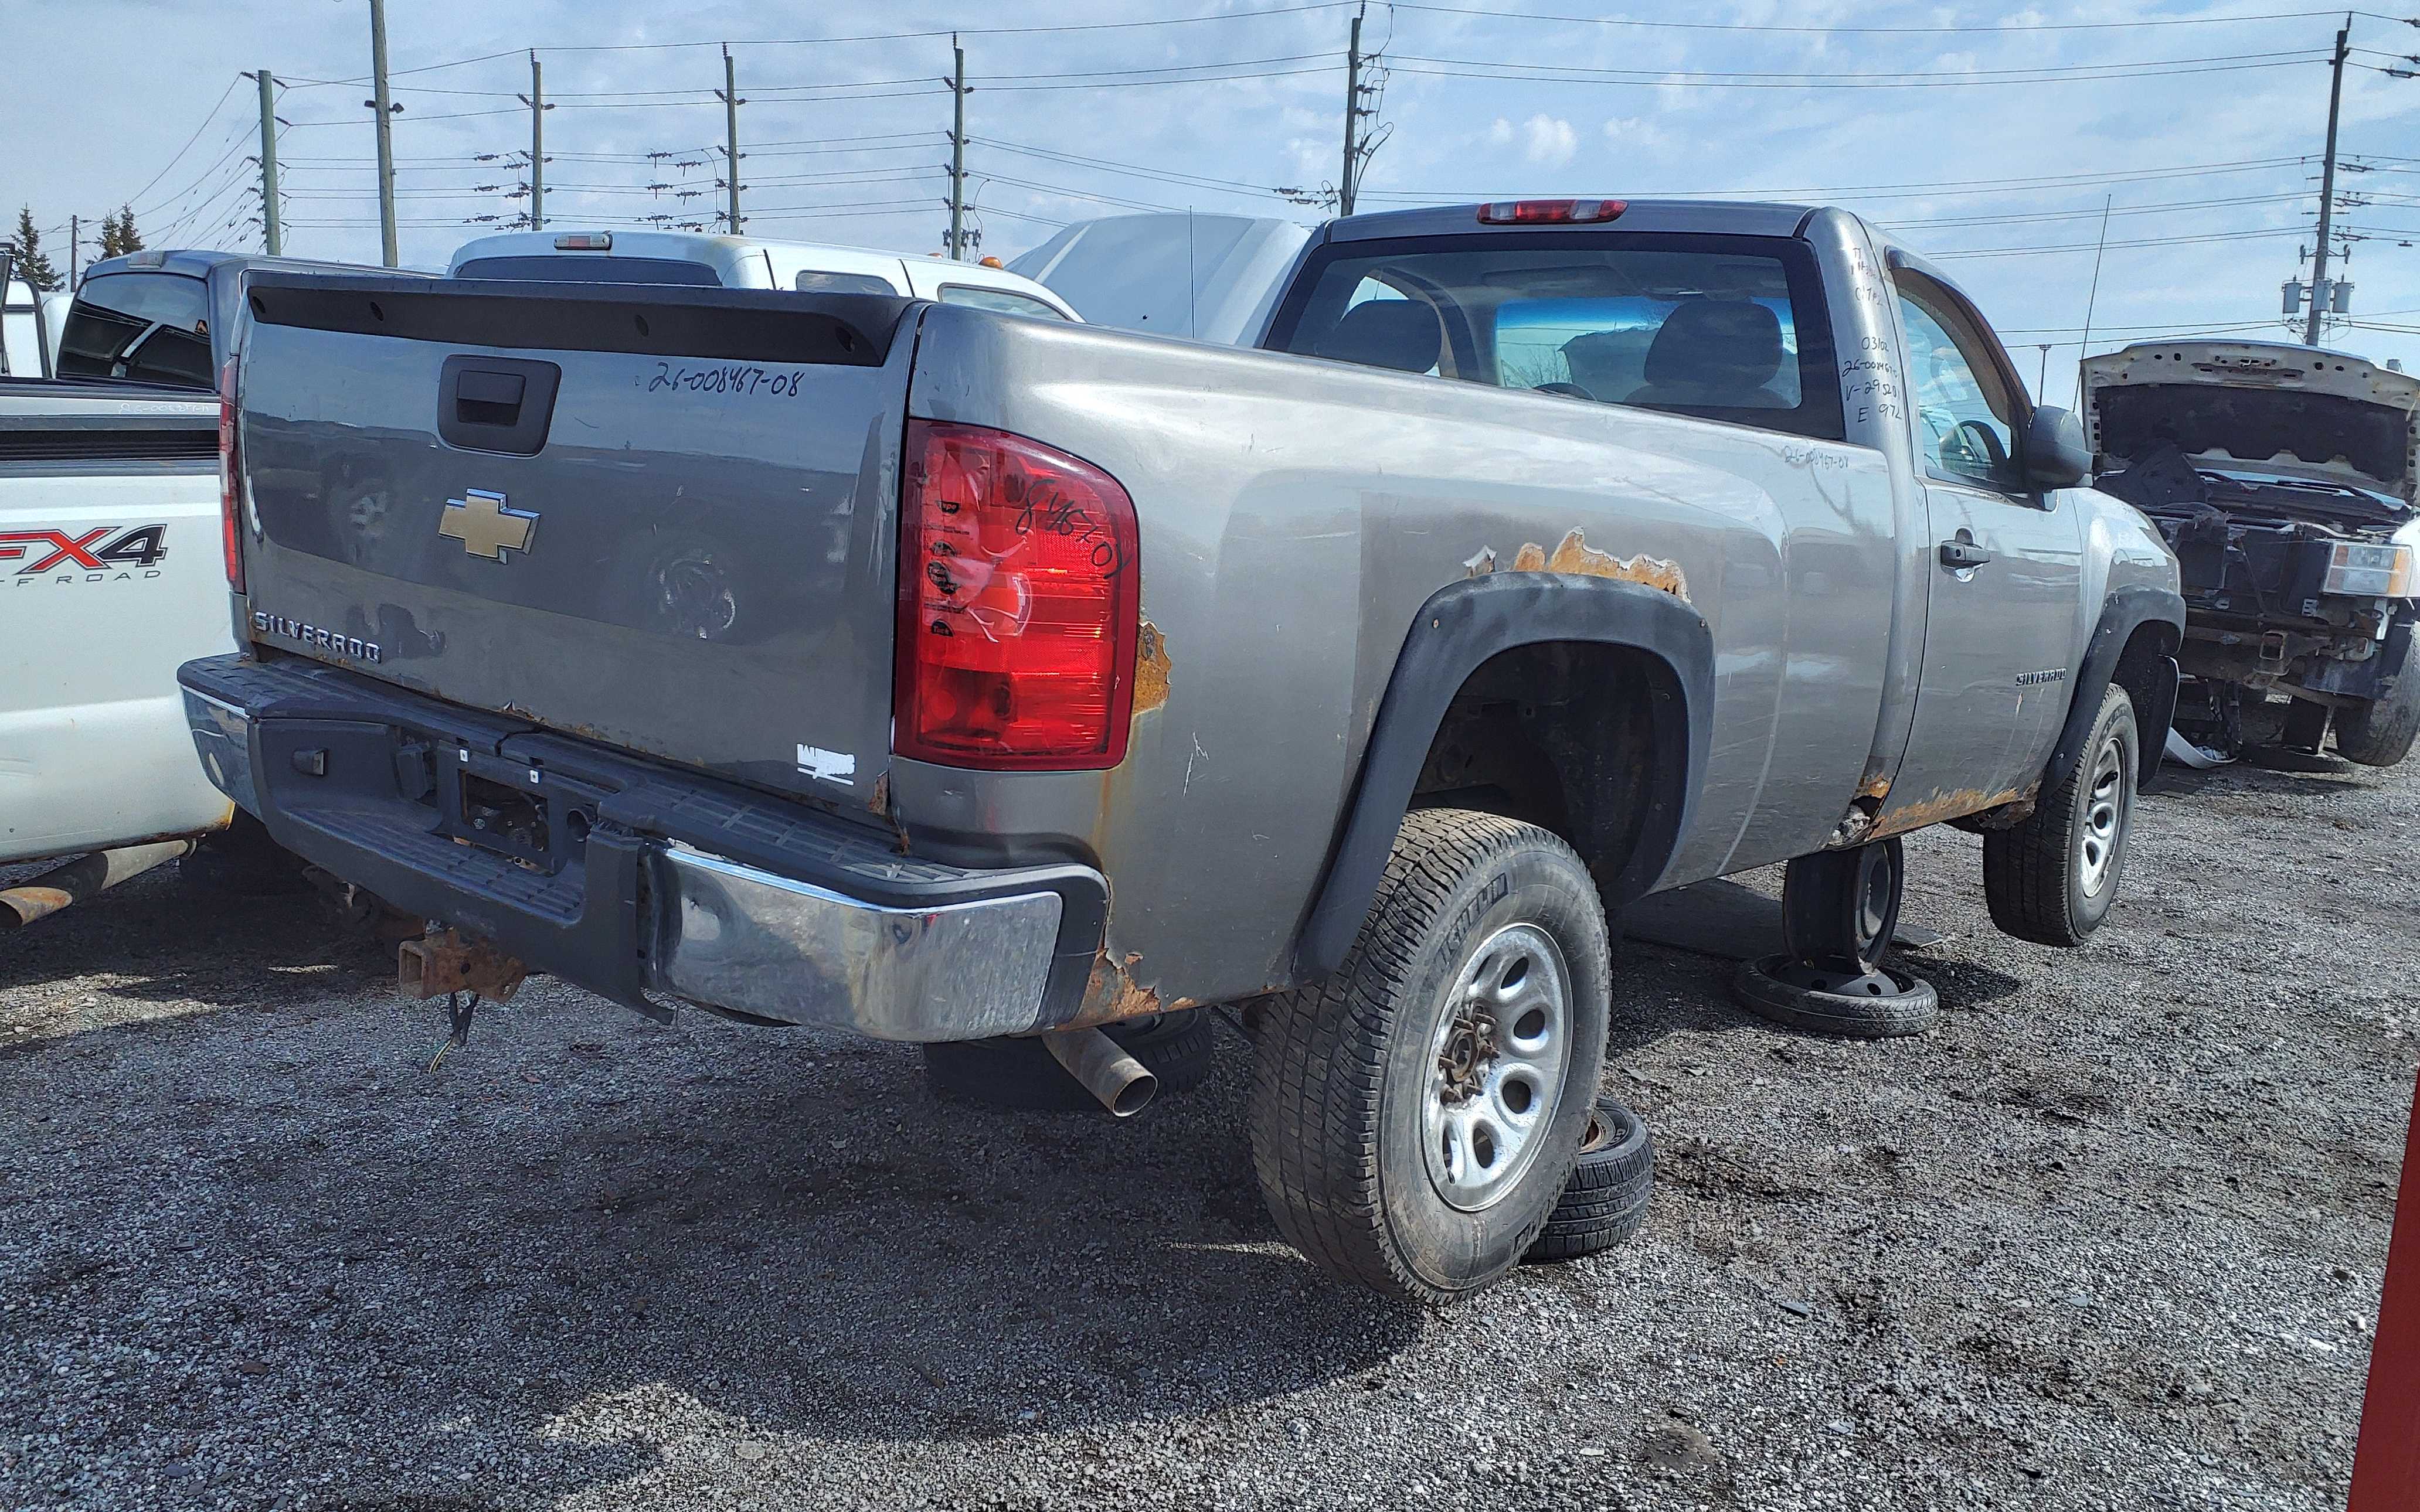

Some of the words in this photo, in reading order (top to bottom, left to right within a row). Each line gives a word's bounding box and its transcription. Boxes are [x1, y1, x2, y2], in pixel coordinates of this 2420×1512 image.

[648, 362, 805, 397] 26-008467-08
[56, 571, 161, 584] ROAD
[254, 611, 381, 663] SILVERADO
[2016, 668, 2066, 686] SILVERADO
